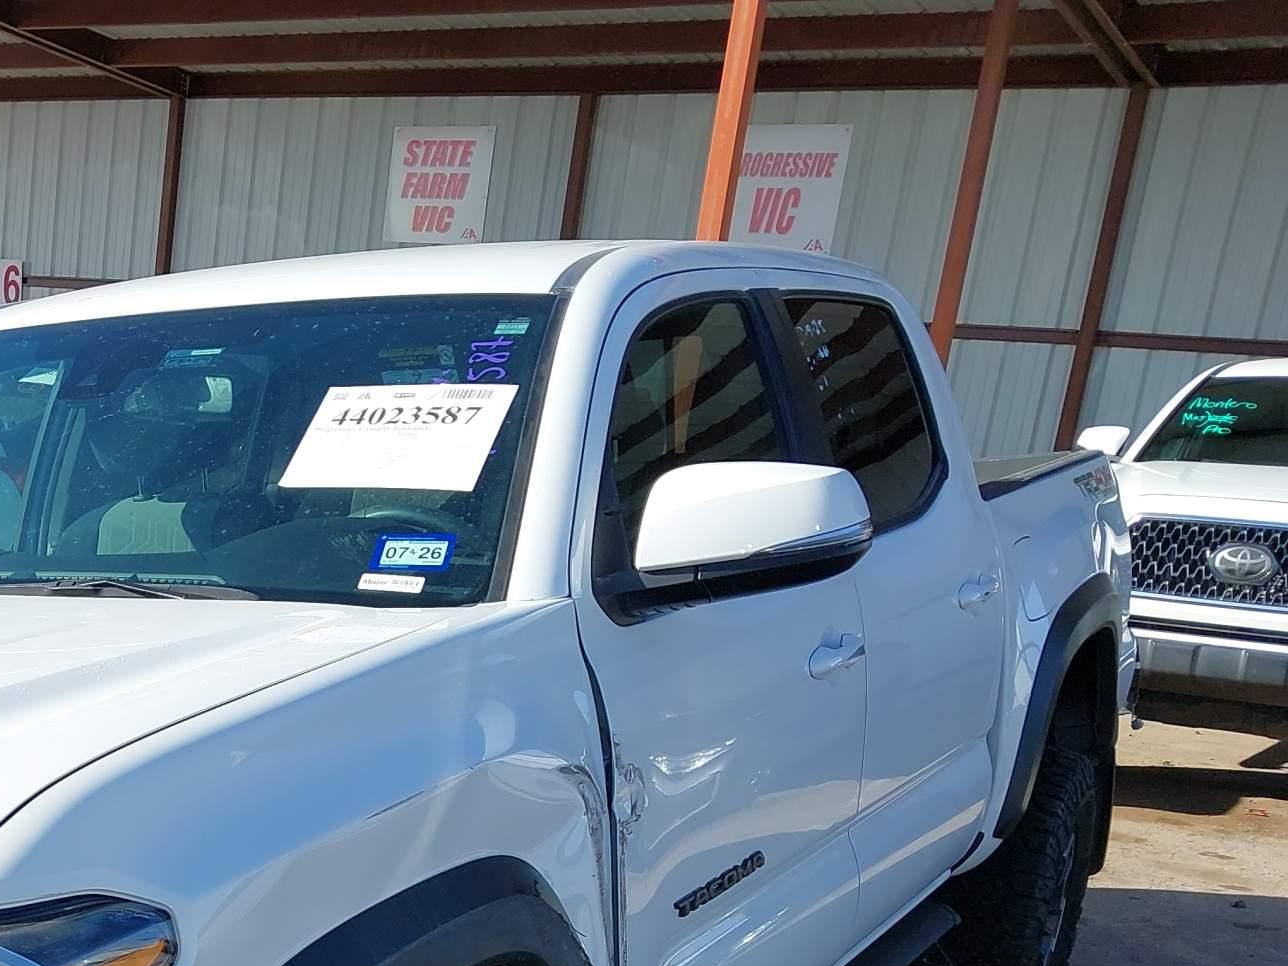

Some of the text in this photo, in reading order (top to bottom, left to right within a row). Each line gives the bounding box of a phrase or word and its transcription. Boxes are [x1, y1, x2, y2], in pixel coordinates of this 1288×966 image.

[402, 138, 477, 167] STATE
[740, 152, 839, 178] ROGRESSIVE
[400, 172, 472, 200] FARM
[411, 205, 456, 233] VIC
[748, 187, 802, 235] VIC
[331, 405, 482, 425] 44023587
[386, 547, 443, 559] 07 26
[673, 850, 765, 917] TACOMA
